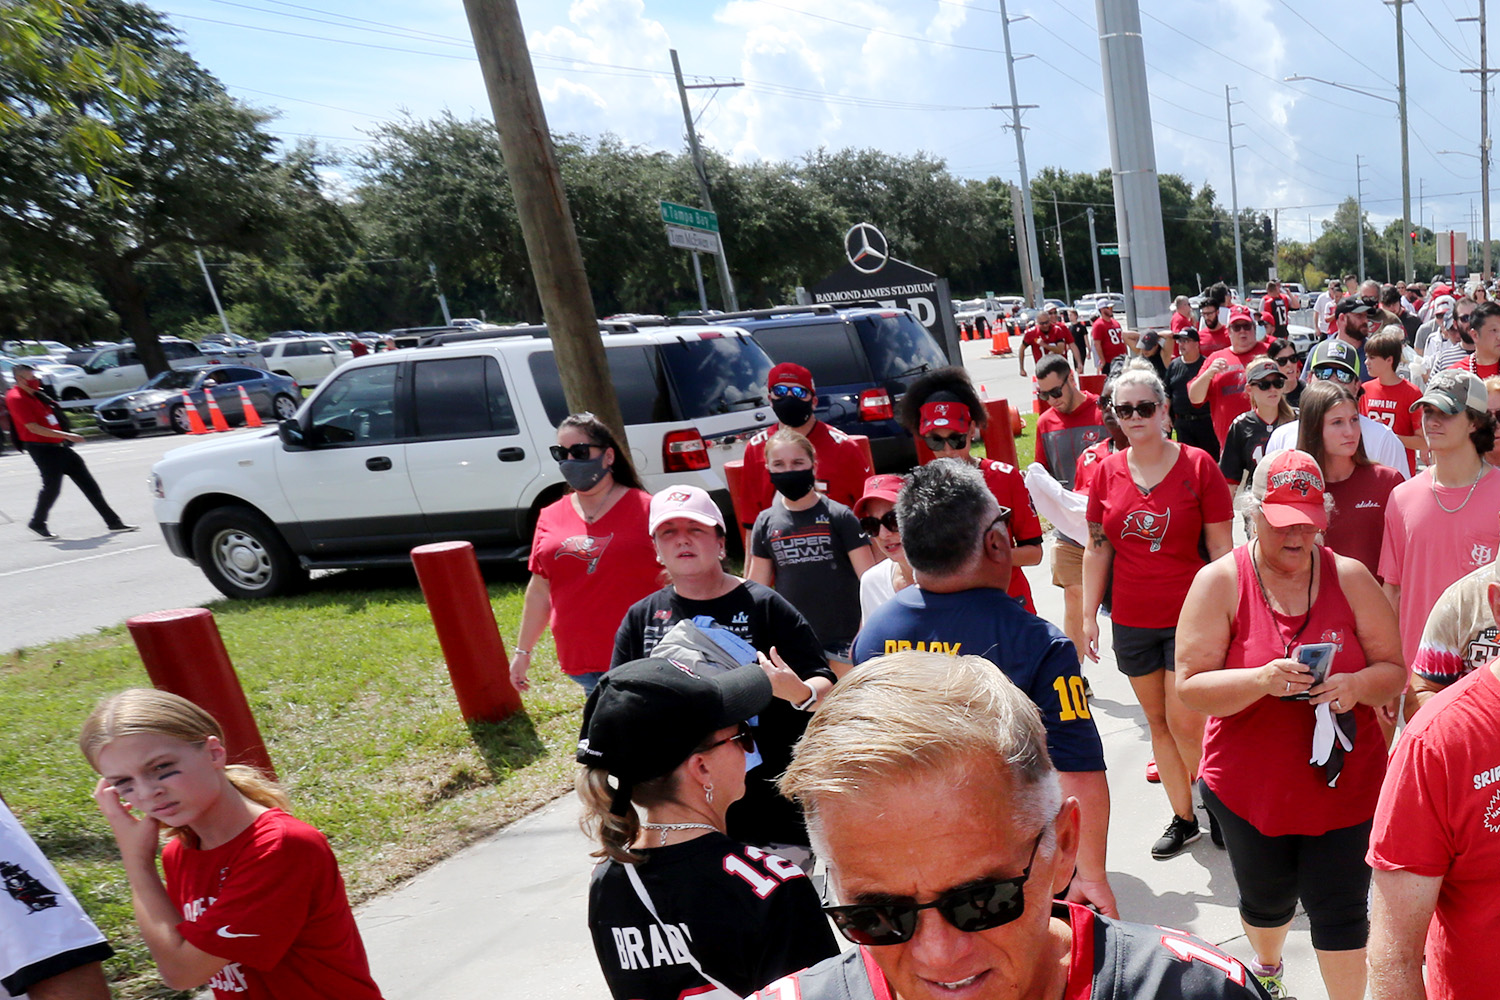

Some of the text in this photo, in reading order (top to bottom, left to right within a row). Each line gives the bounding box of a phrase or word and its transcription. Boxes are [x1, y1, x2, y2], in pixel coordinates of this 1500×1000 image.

[669, 206, 694, 223] Tampa
[815, 283, 934, 303] RAYMOND JAMES STADIUM
[1368, 398, 1398, 410] TAMPA BAY
[1270, 470, 1323, 492] BUCCANEERS
[771, 536, 831, 550] SUPER
[774, 545, 834, 560] BOWL
[1052, 675, 1091, 721] 10
[723, 845, 806, 899] 12
